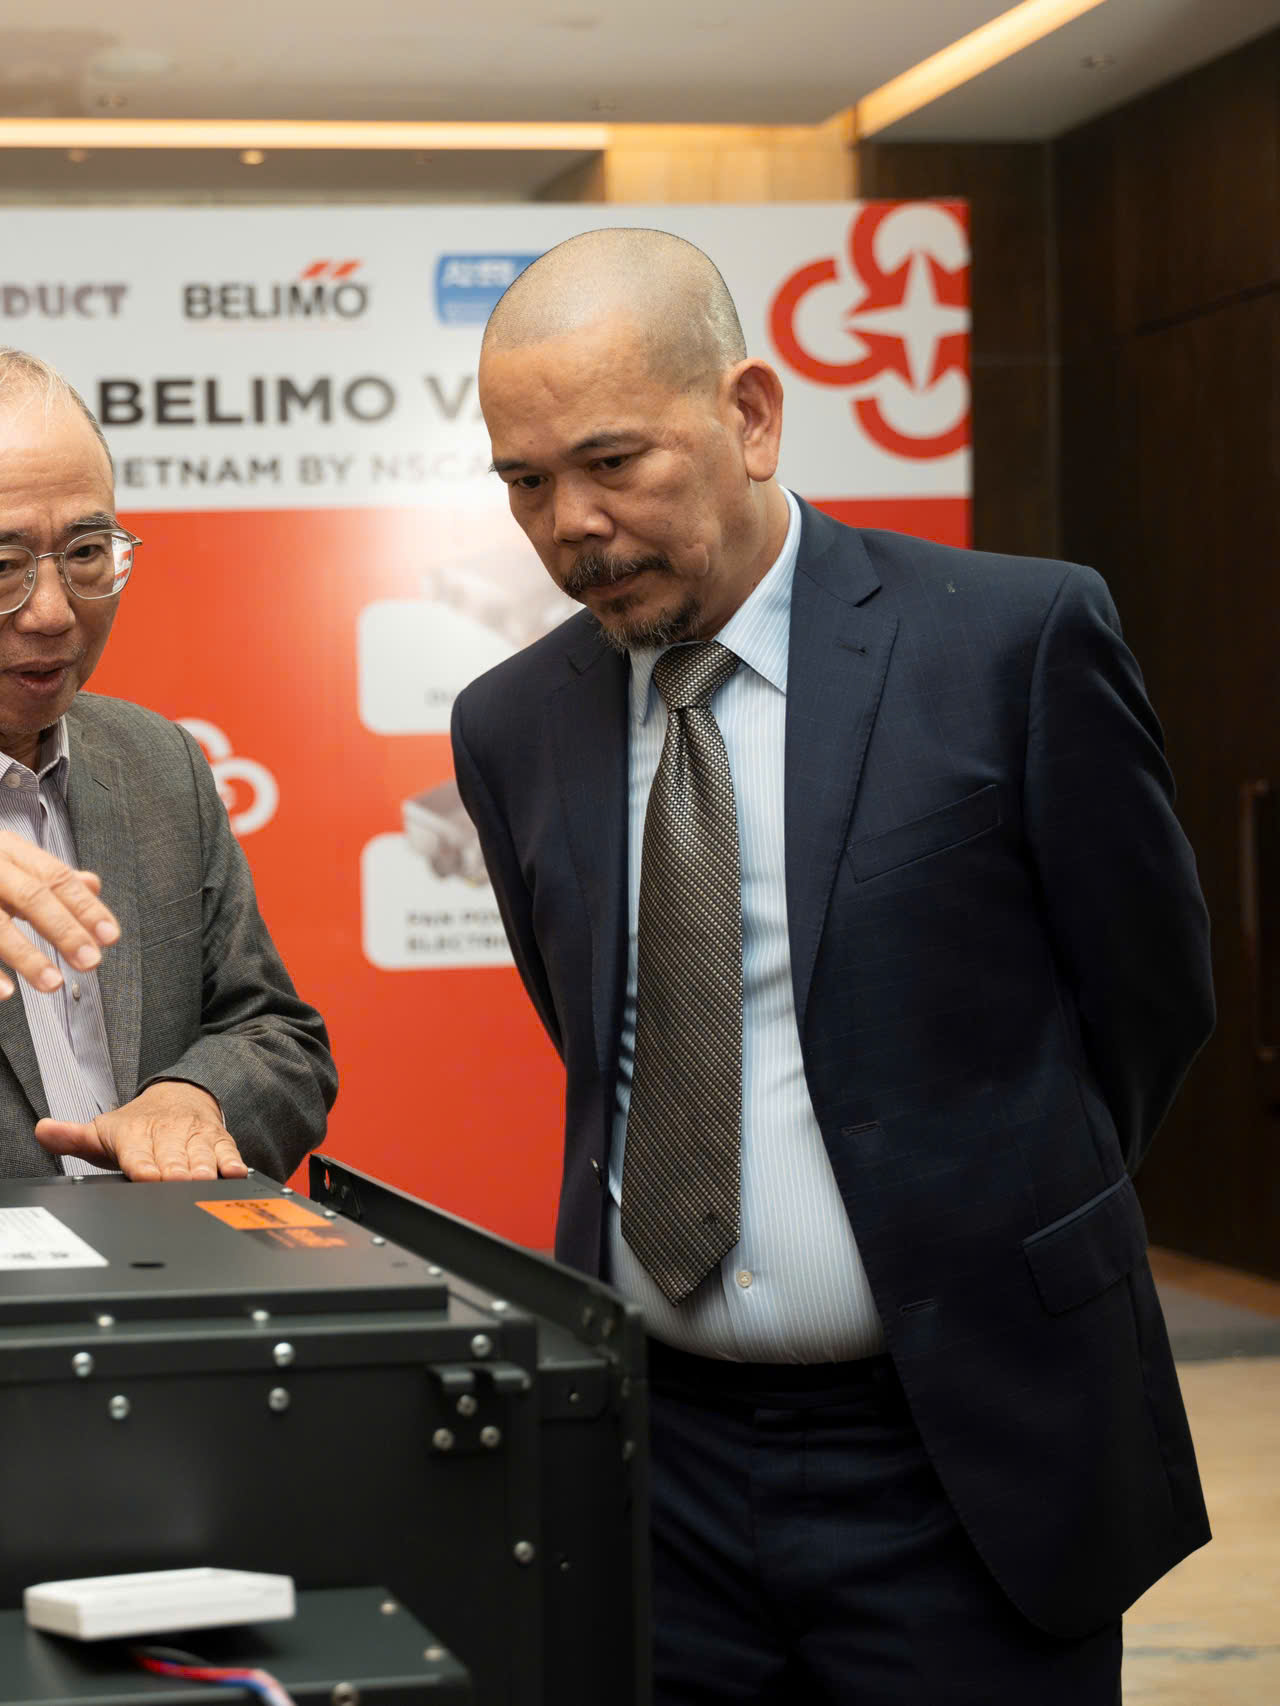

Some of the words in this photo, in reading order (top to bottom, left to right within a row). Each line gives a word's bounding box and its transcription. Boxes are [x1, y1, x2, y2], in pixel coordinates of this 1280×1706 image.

[182, 281, 370, 320] BELIMO
[97, 375, 397, 426] BELIMO
[423, 374, 484, 423] V
[298, 454, 355, 487] BY
